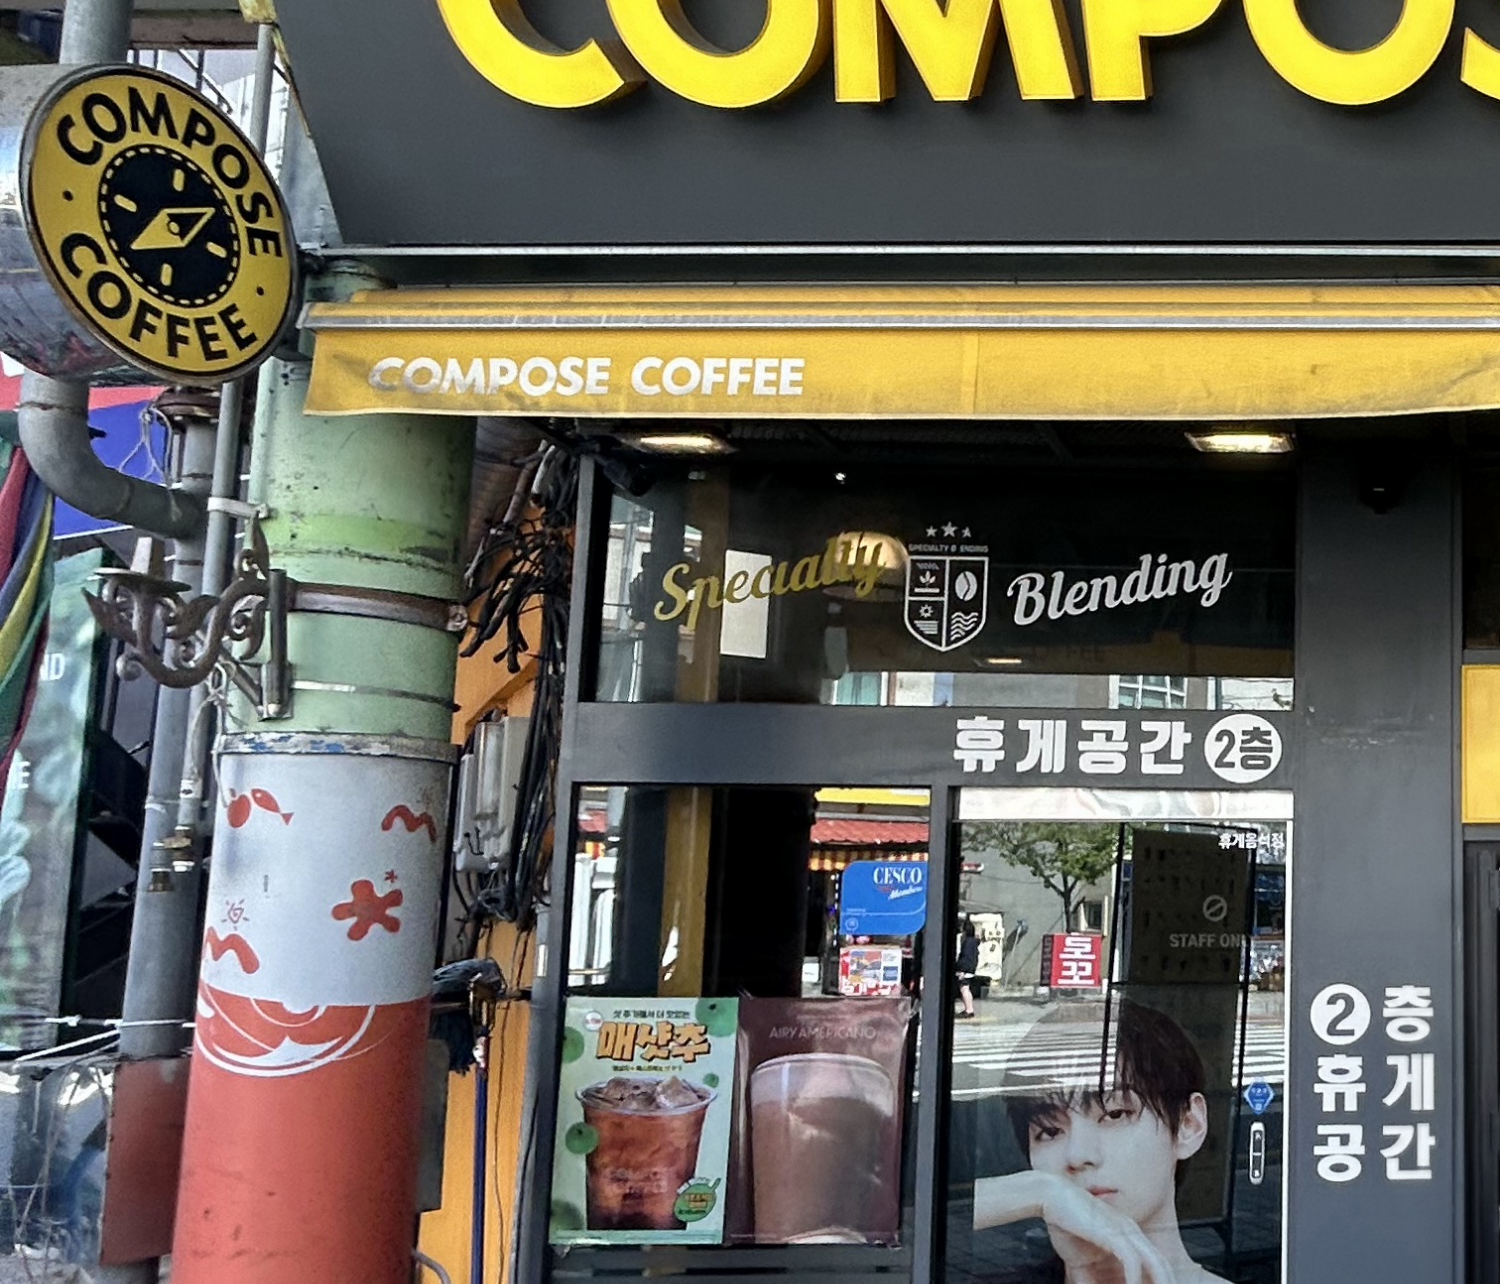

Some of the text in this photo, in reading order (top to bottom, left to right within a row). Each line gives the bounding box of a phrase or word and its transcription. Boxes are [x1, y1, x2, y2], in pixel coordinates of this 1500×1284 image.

[56, 86, 283, 258] COMPOSE
[60, 233, 259, 363] COFFEE
[367, 356, 806, 397] COMPOSE COFFEE
[1006, 551, 1232, 626] Blending
[953, 715, 1276, 775] 휴게공간 2층
[873, 866, 923, 885] CESCO
[1169, 933, 1217, 948] STAFF
[596, 1021, 711, 1063] 매샷추
[768, 1026, 877, 1040] AIRY AMERICANO
[1310, 983, 1434, 1046] 2층
[1313, 1053, 1435, 1112] 휴게
[1313, 1122, 1436, 1182] 공간
